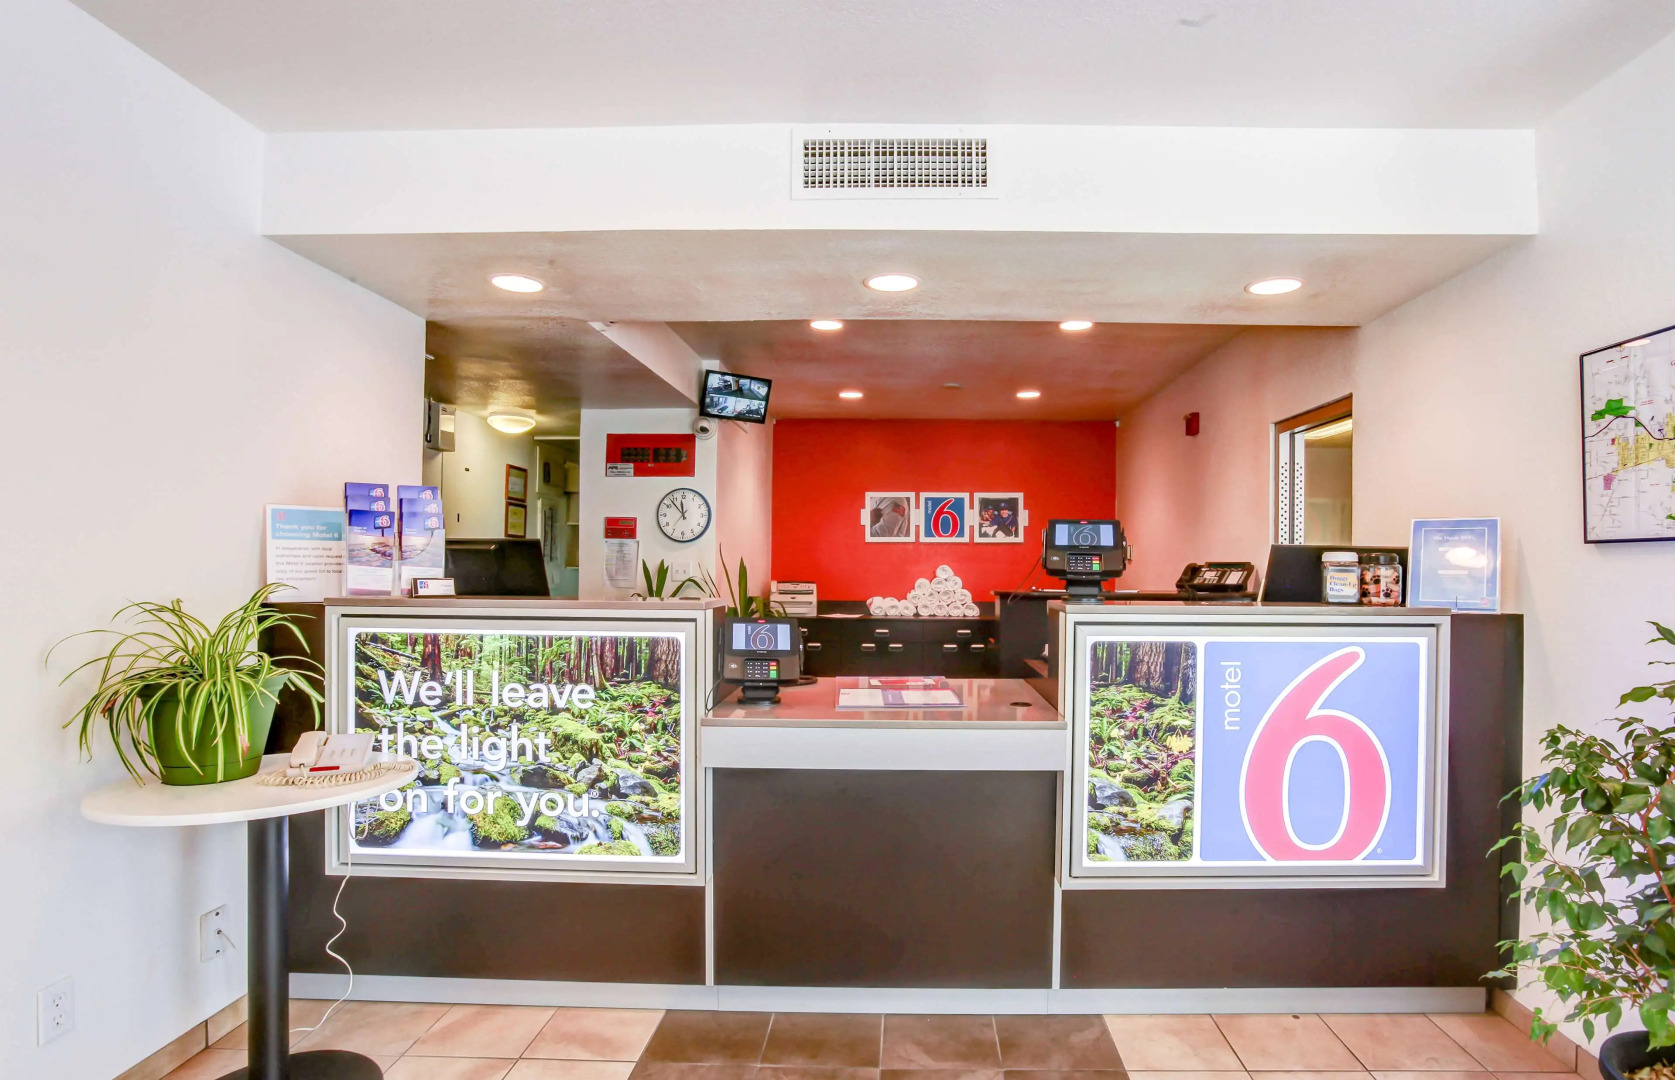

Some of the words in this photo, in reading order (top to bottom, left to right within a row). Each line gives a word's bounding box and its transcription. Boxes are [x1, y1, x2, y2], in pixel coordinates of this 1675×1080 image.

[380, 515, 390, 527] 6
[429, 517, 439, 528] 6
[931, 498, 960, 538] 6
[1073, 525, 1097, 545] 6
[751, 624, 774, 650] 6
[378, 669, 473, 705] We'll
[492, 670, 595, 709] leave
[1220, 661, 1242, 730] motel
[378, 722, 444, 759] the
[460, 724, 551, 771] light
[1239, 646, 1392, 861] 6
[380, 789, 428, 812] on
[444, 777, 502, 815] for
